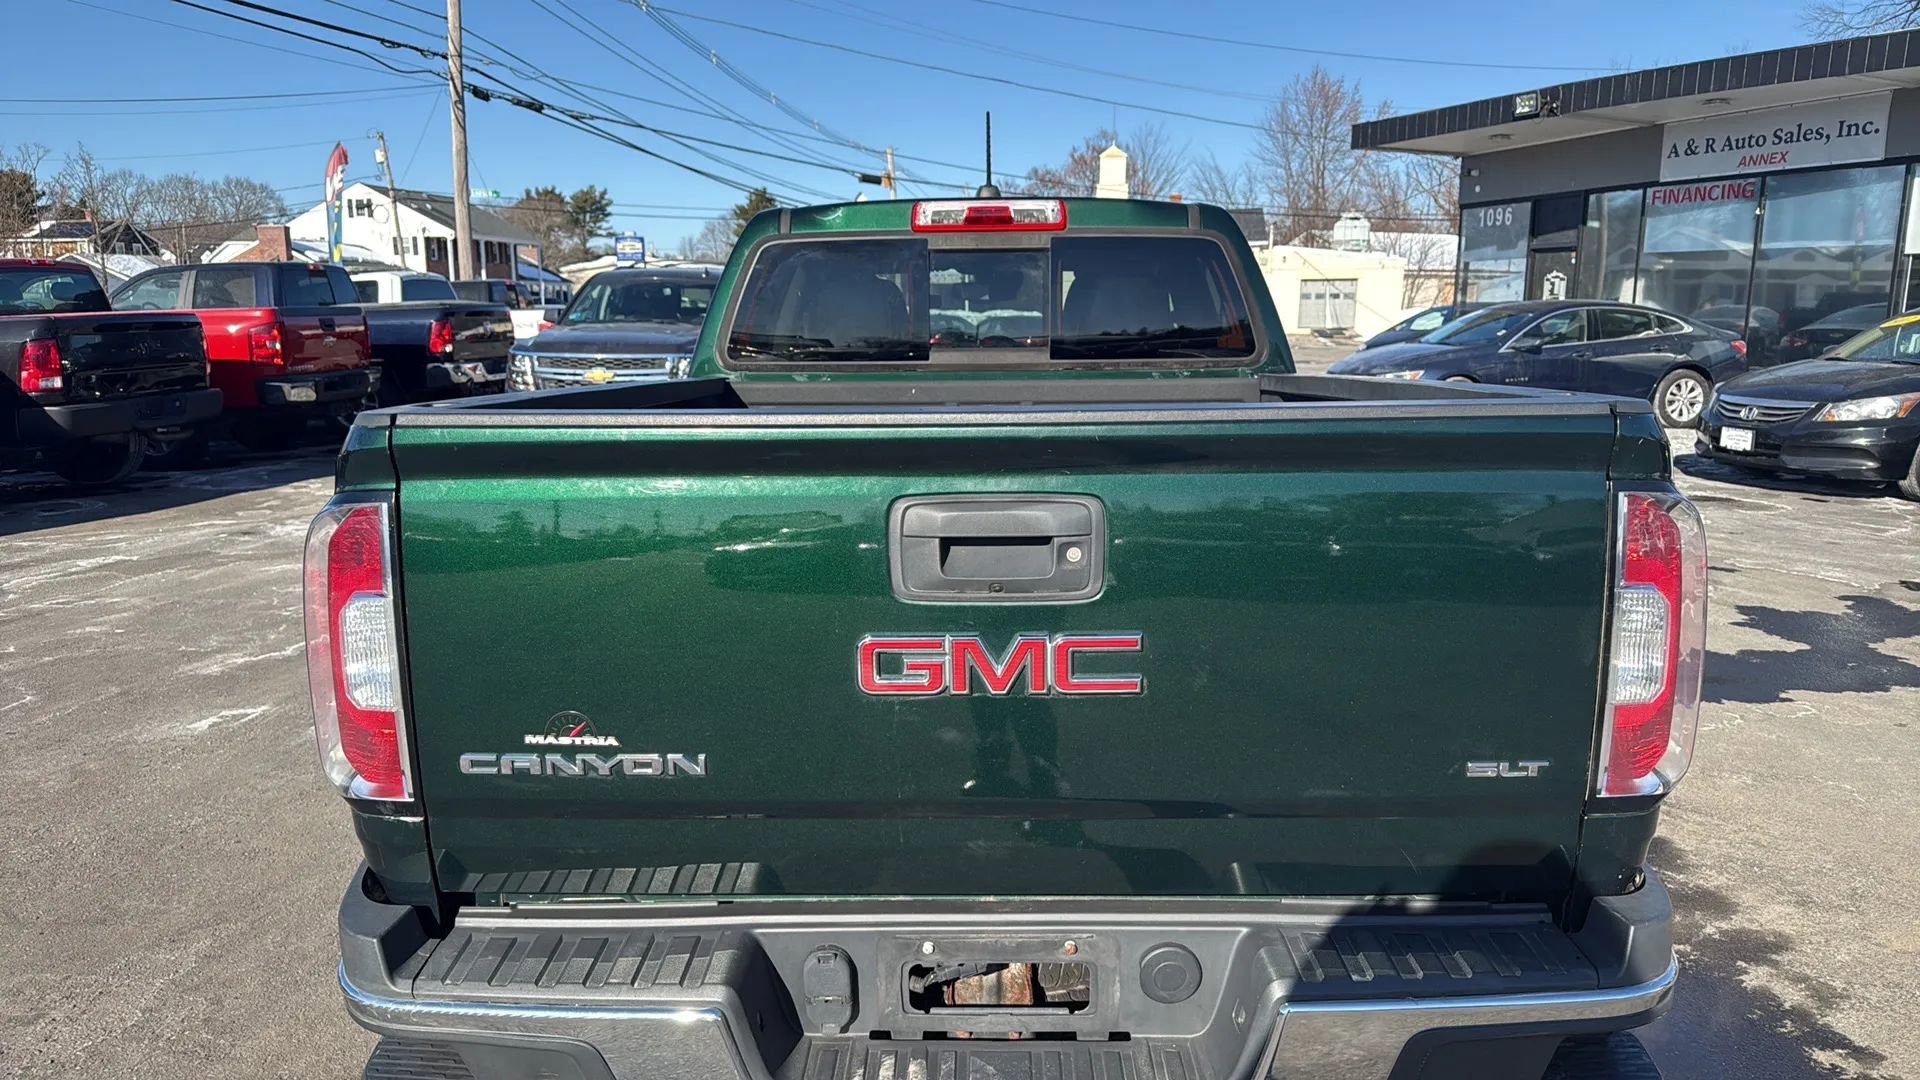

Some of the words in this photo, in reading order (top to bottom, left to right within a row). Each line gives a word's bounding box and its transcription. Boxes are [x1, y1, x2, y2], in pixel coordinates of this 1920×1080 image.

[1667, 142, 1680, 159] A
[1684, 138, 1699, 157] &
[1703, 137, 1717, 154] R
[1720, 134, 1767, 152] Auto
[1772, 123, 1831, 146] Sales,
[1836, 119, 1880, 138] Inc.
[1737, 151, 1789, 168] ANNEX
[1651, 181, 1756, 206] FINANCING
[1479, 207, 1513, 227] 1096
[857, 632, 1143, 695] GMC
[524, 734, 621, 746] MASTRIA
[459, 752, 706, 776] CANYON
[1466, 761, 1549, 777] SLT
